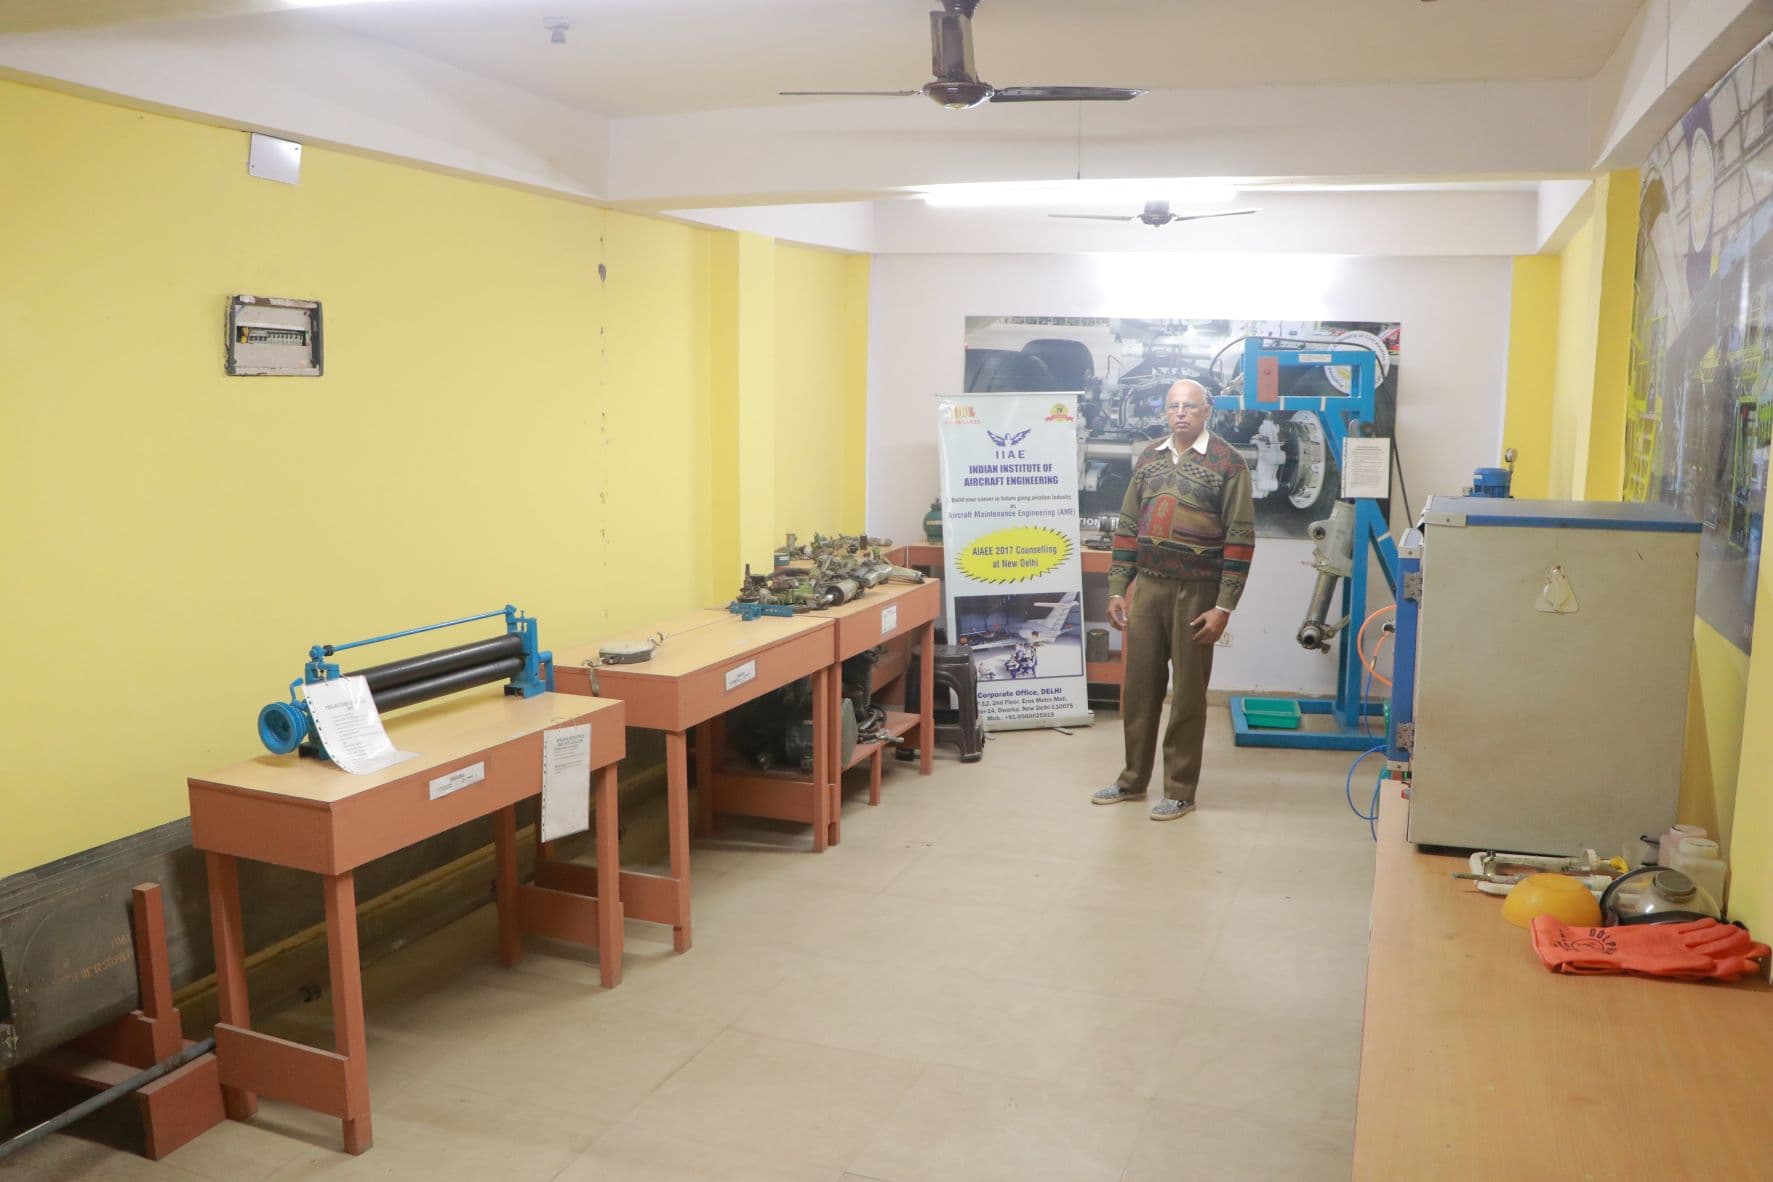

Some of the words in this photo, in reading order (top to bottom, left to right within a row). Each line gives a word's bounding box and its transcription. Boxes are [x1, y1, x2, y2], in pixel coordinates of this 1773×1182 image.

[996, 450, 1025, 459] IIAE
[969, 464, 998, 474] INDIAN
[1000, 463, 1041, 473] INSTITUTE
[1043, 463, 1052, 472] OF
[964, 476, 1004, 487] AIRCRAFT
[1006, 475, 1059, 486] ENGINEERING
[948, 510, 973, 519] Aircraft
[974, 509, 1016, 518] Maintenance
[1018, 508, 1056, 518] Engineering
[1057, 507, 1076, 517] (AME)
[972, 546, 993, 556] AIAEE
[995, 546, 1014, 555] 2017
[1015, 545, 1057, 555] Counselling
[992, 560, 1000, 569] at
[1002, 559, 1018, 568] New
[1020, 558, 1039, 568] Delhi
[977, 691, 1014, 699] Corporate
[1015, 689, 1040, 697] Office,
[1041, 687, 1062, 695] DELHI
